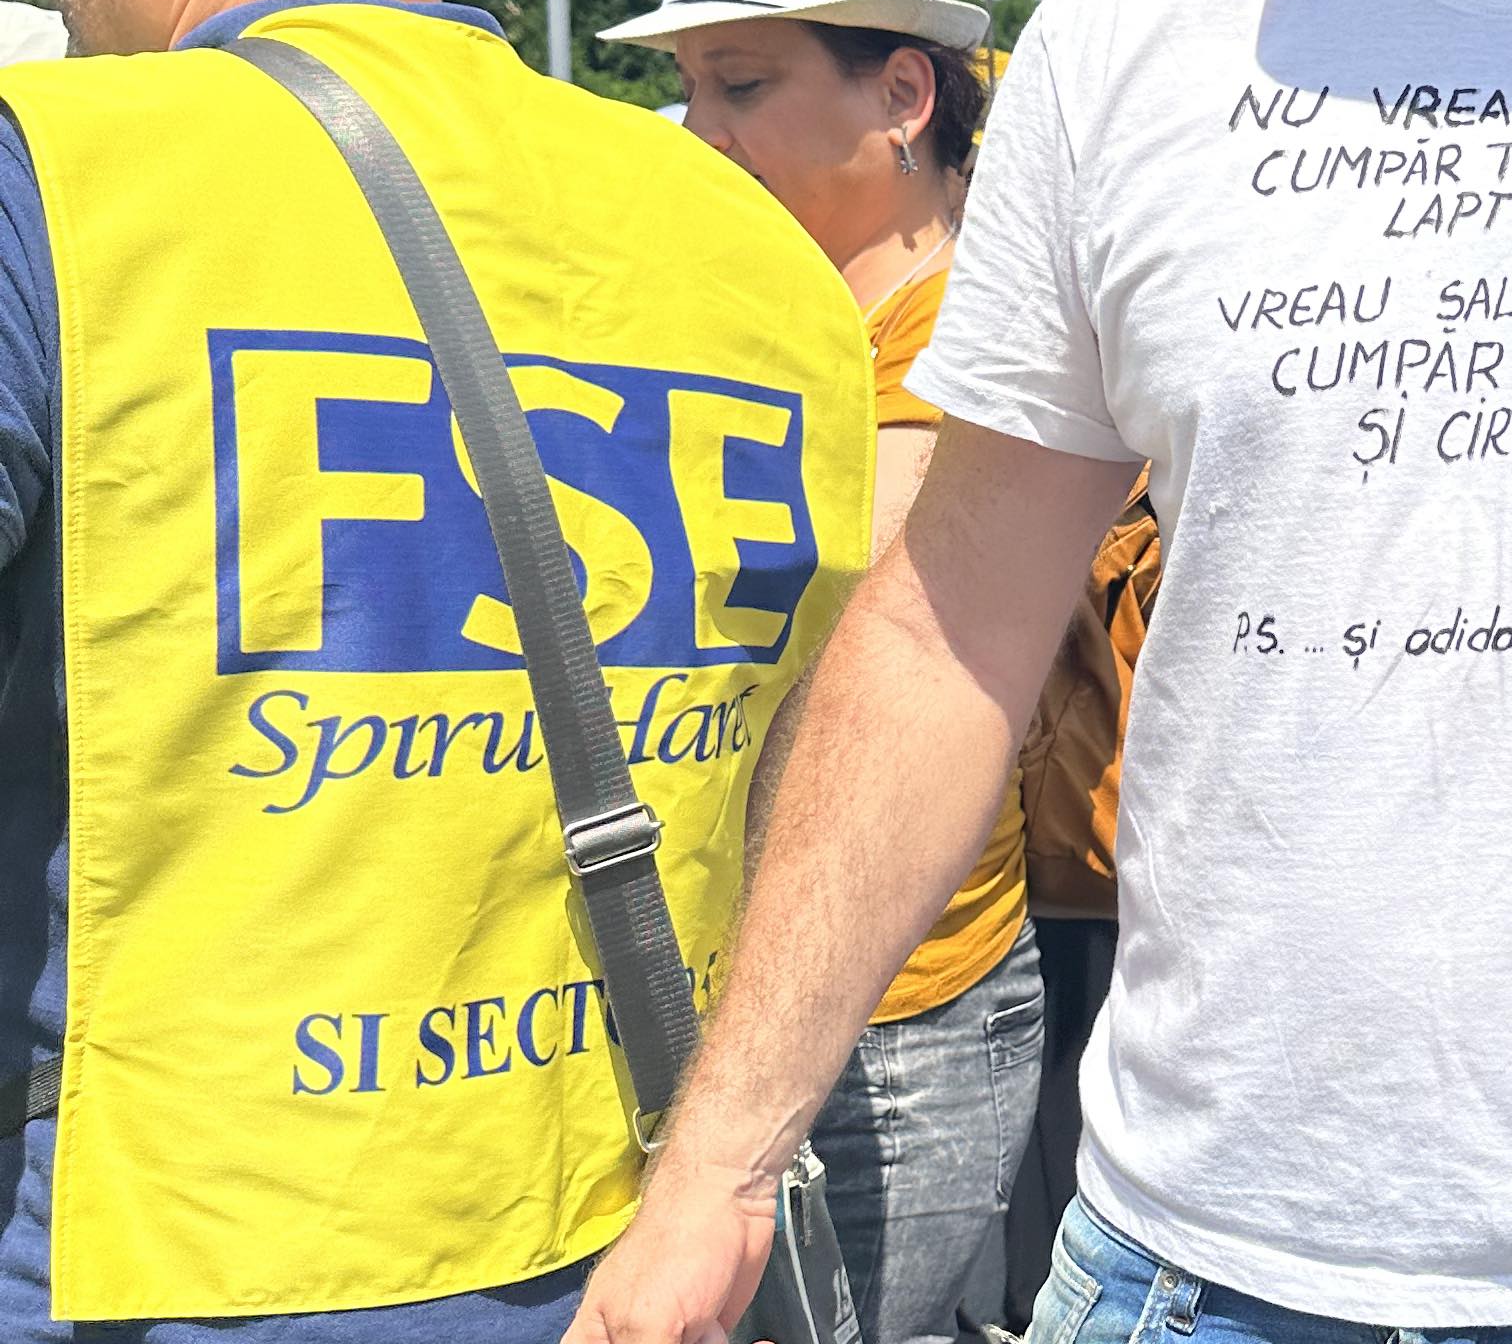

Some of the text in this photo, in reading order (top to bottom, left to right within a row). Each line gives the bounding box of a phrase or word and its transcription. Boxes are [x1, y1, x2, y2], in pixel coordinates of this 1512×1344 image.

[1226, 82, 1331, 134] NU
[1216, 274, 1393, 333] VREAU
[1341, 618, 1383, 673] și
[227, 689, 544, 814] Spiru
[292, 978, 622, 1097] SI SECT
